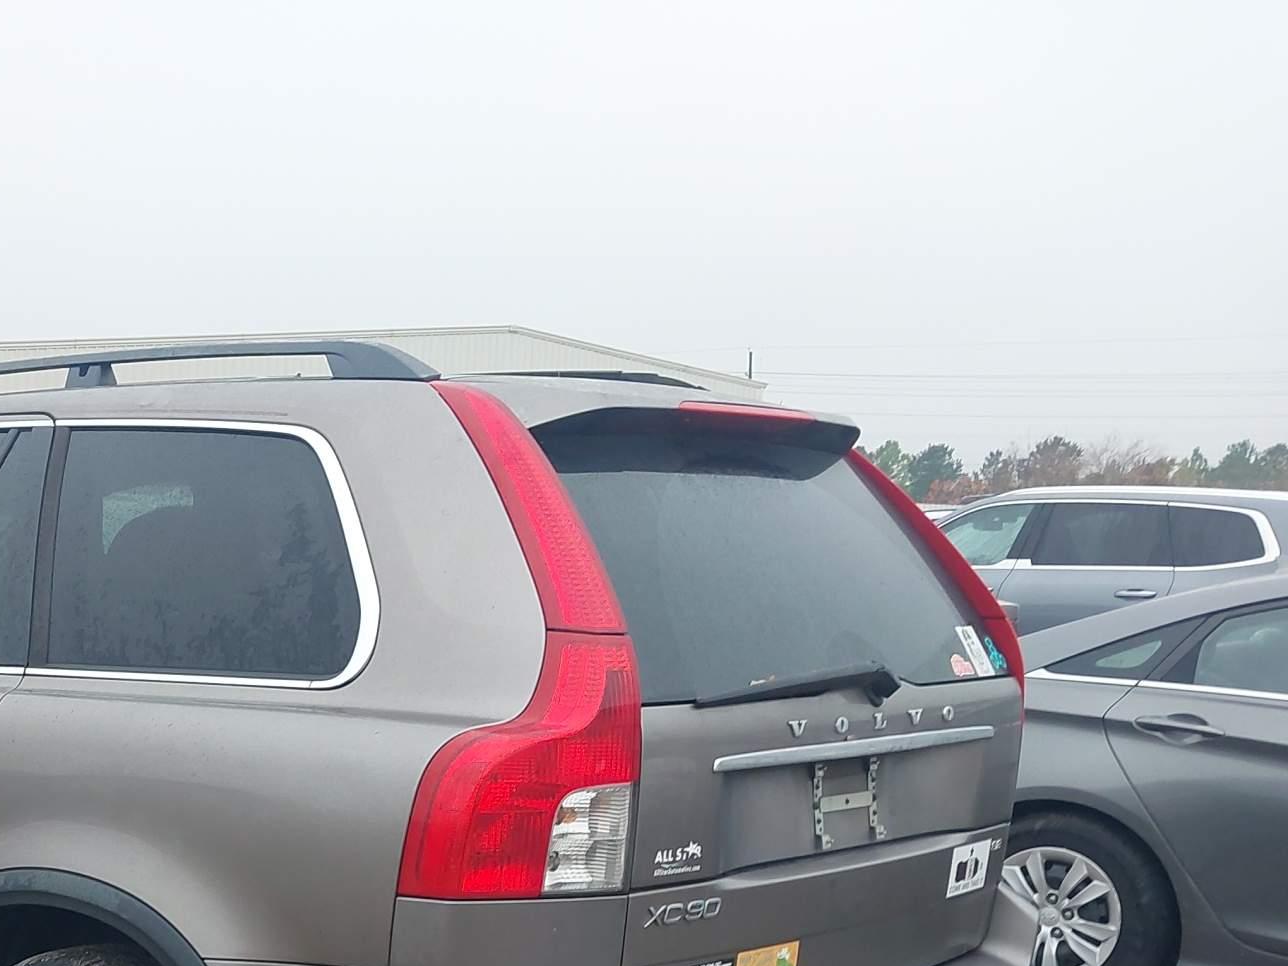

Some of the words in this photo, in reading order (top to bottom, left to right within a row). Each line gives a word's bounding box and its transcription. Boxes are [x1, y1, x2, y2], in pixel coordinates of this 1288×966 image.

[788, 705, 955, 738] VOLVO
[654, 849, 674, 864] ALL
[644, 897, 722, 929] XC90
